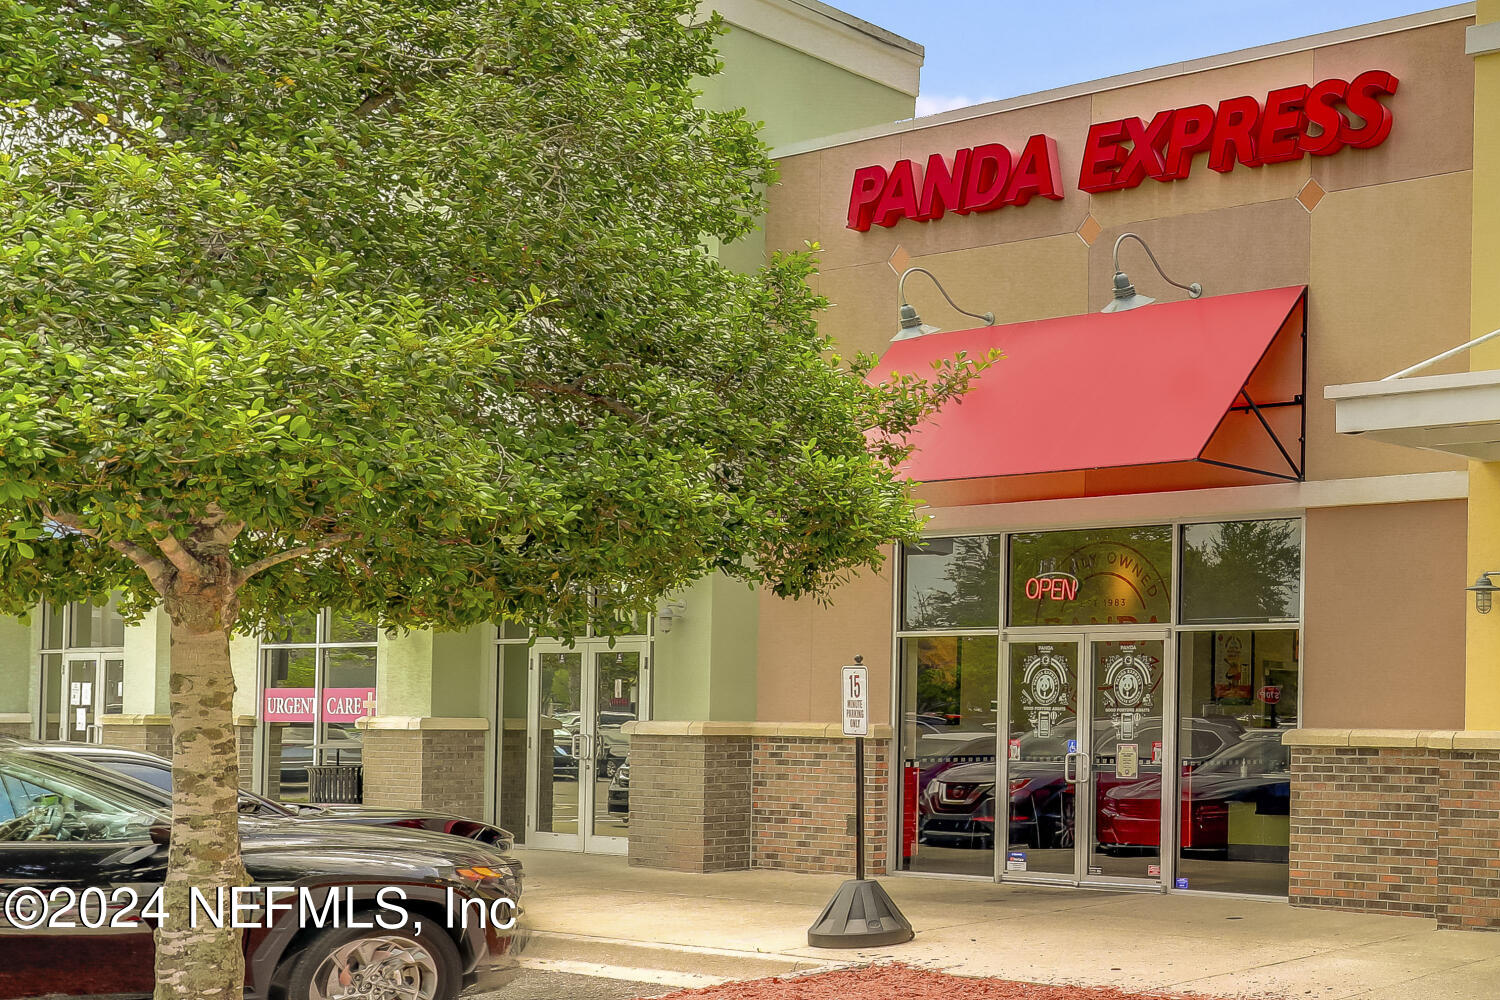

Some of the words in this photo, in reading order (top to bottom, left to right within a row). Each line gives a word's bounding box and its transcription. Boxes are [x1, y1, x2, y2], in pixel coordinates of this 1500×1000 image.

[846, 133, 1065, 233] PANDA
[1078, 70, 1399, 194] EXPRESS
[1107, 551, 1158, 598] OWNED
[1025, 577, 1077, 601] OPEN
[848, 674, 861, 698] 15
[267, 697, 316, 714] URGENT
[326, 697, 362, 715] CARE
[846, 709, 864, 719] PARKING
[847, 700, 863, 708] MINUTE
[849, 719, 861, 729] ONLY
